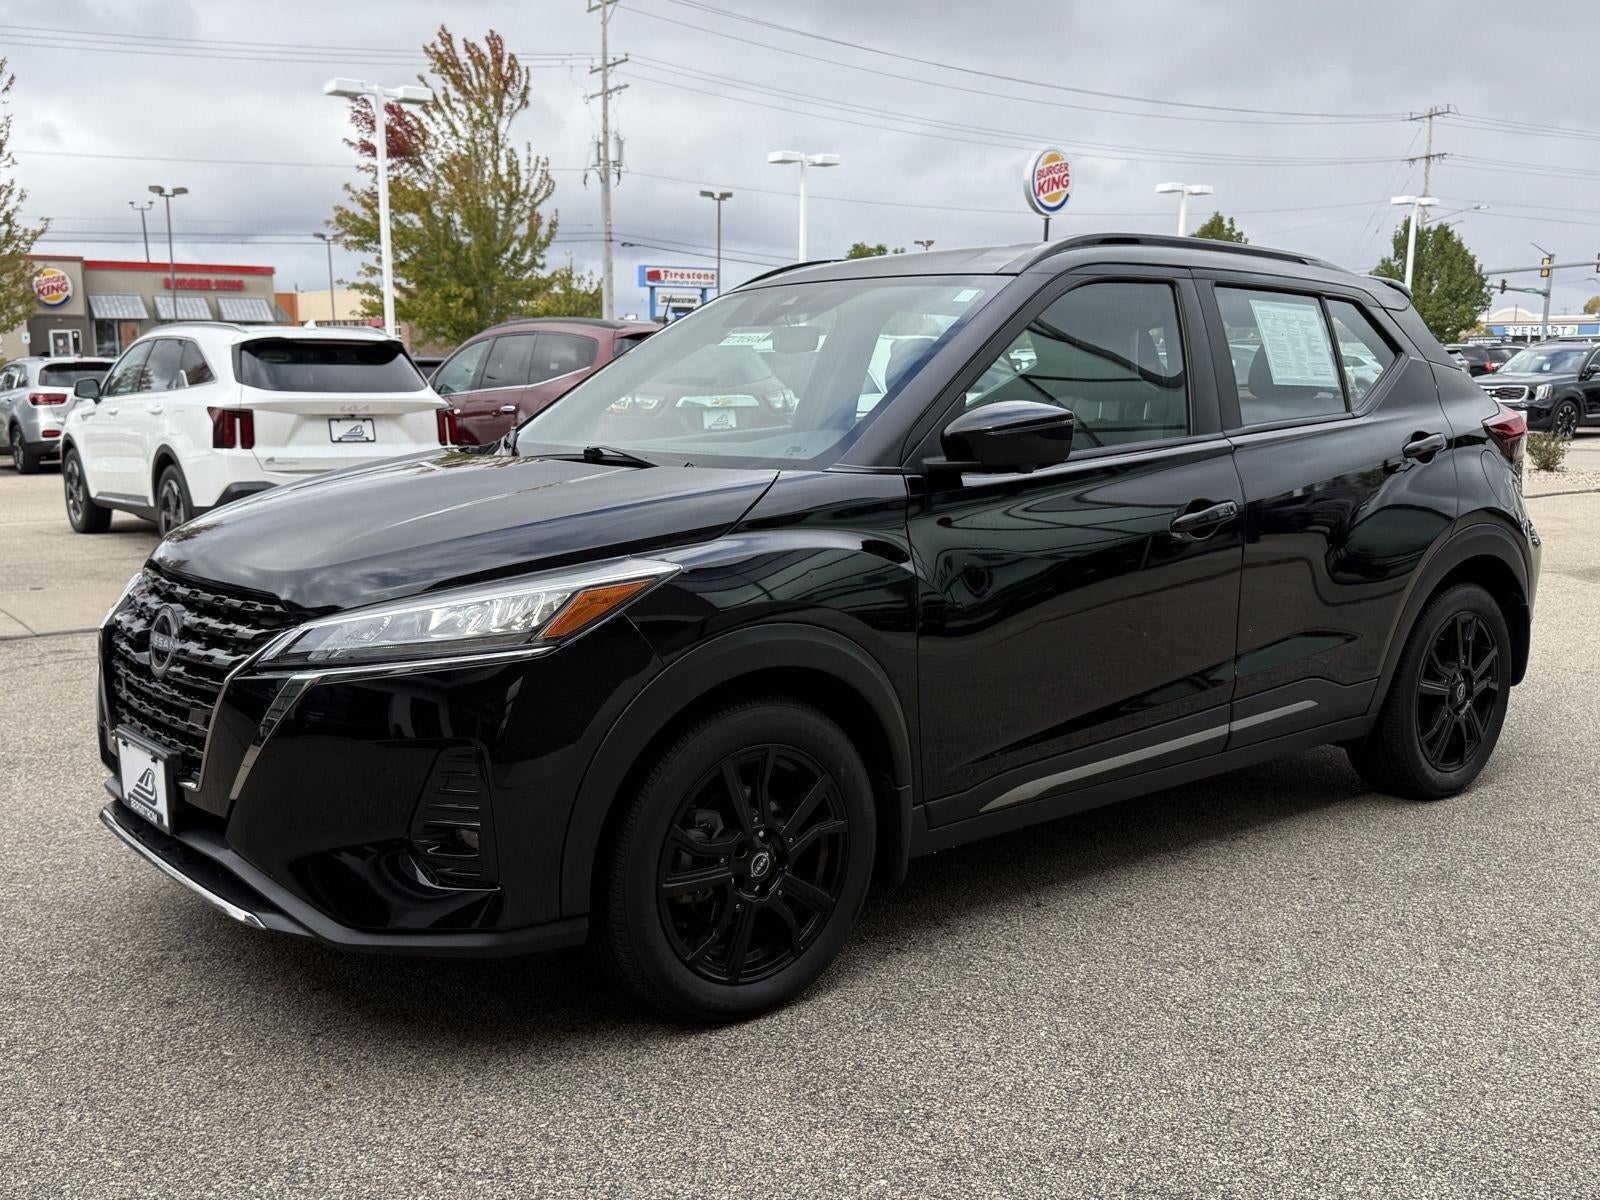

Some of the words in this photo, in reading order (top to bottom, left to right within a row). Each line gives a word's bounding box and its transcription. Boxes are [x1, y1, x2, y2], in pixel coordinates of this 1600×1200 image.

[1036, 161, 1070, 181] BURGER
[1037, 172, 1070, 197] KING
[663, 269, 716, 280] Firestone
[37, 281, 69, 298] KING
